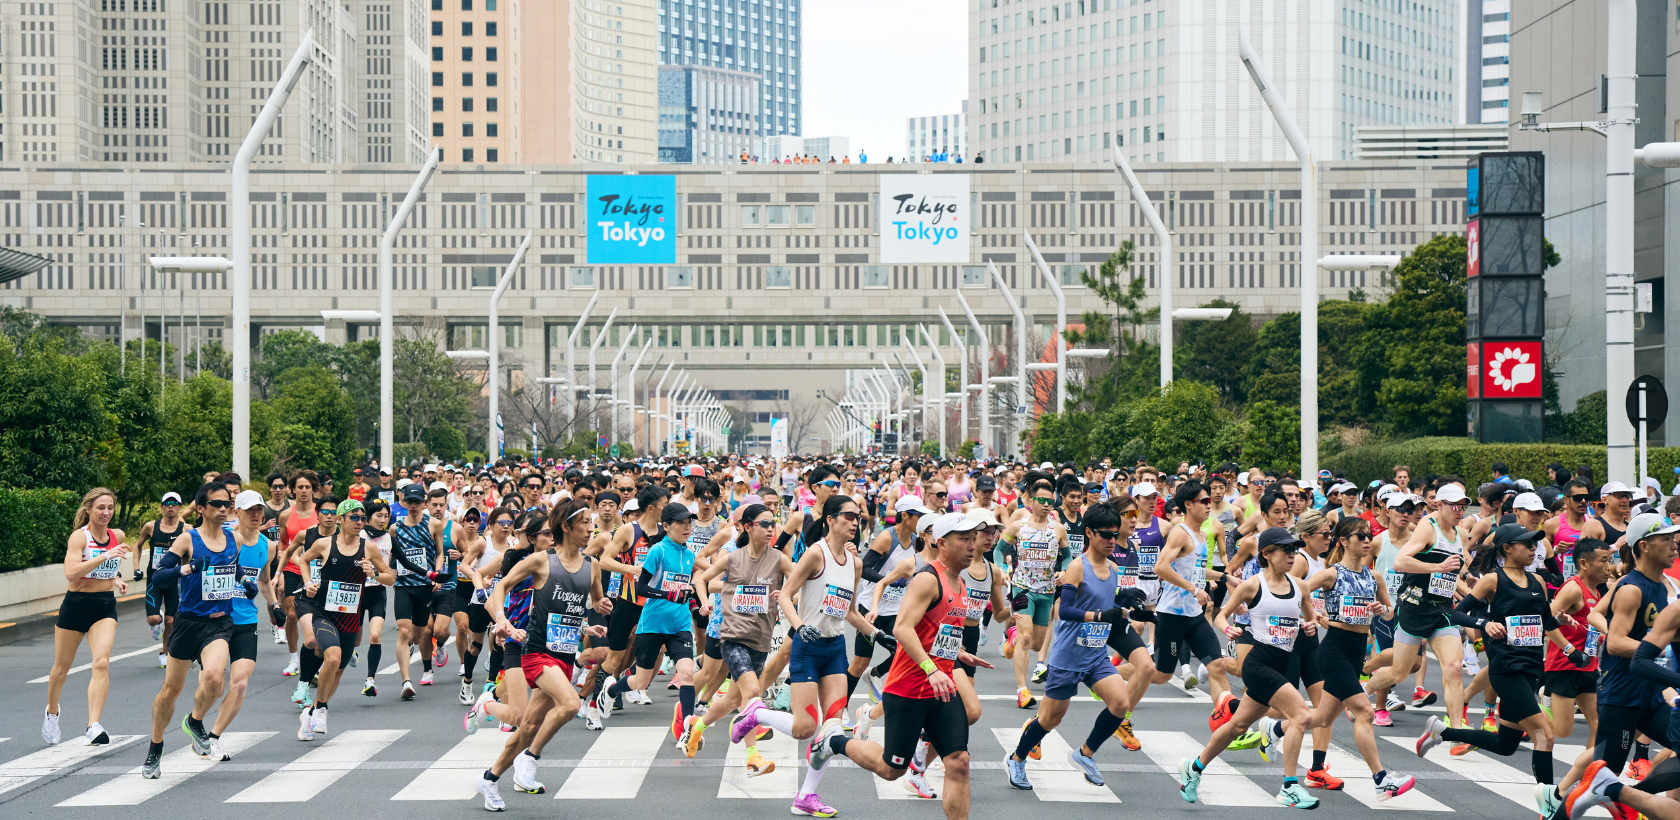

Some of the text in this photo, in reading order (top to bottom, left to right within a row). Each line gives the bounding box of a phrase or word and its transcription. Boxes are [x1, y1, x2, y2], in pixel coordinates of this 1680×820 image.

[598, 194, 664, 226] Tokyo
[893, 193, 957, 225] Tokyo
[597, 221, 665, 247] Tokyo
[892, 221, 958, 245] Tokyo
[1026, 549, 1047, 560] 20640
[1138, 554, 1156, 564] 3039
[203, 579, 210, 587] A
[212, 576, 235, 589] 19711
[335, 592, 357, 604] 19833
[947, 606, 967, 618] JAPAN
[1342, 605, 1370, 618] HONMA
[554, 626, 577, 642] 3045
[1087, 623, 1107, 636] 3097
[1515, 626, 1540, 638] OGAWA
